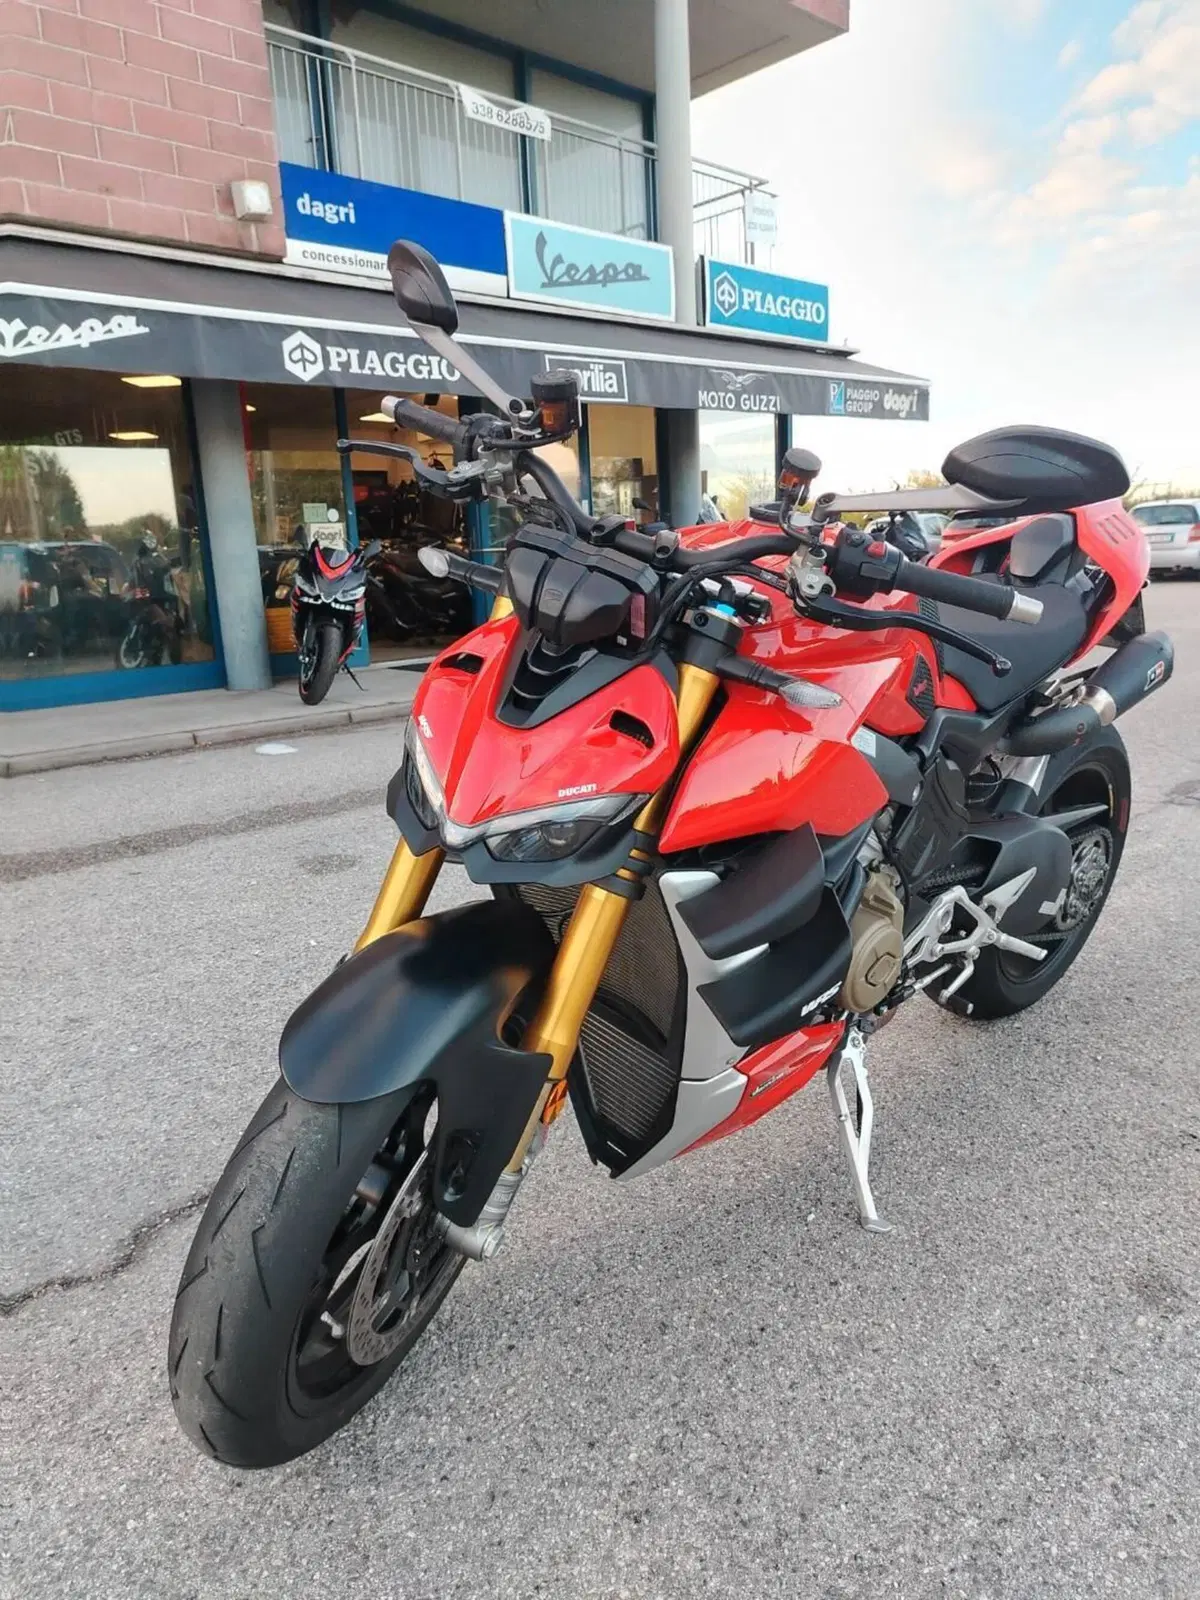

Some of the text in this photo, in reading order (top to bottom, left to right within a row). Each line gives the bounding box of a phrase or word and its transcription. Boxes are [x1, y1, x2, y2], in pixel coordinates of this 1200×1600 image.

[296, 191, 356, 225] dagri
[302, 249, 388, 271] concessionar
[535, 230, 651, 288] Vespa
[741, 287, 826, 324] PIAGGIO
[565, 363, 619, 394] rilia
[698, 390, 781, 412] MOTO GUZZI
[846, 387, 880, 401] PIAGGIO
[883, 388, 919, 418] dagri
[845, 400, 874, 413] GROUP
[54, 428, 83, 446] GTS
[558, 783, 597, 798] DUCATI
